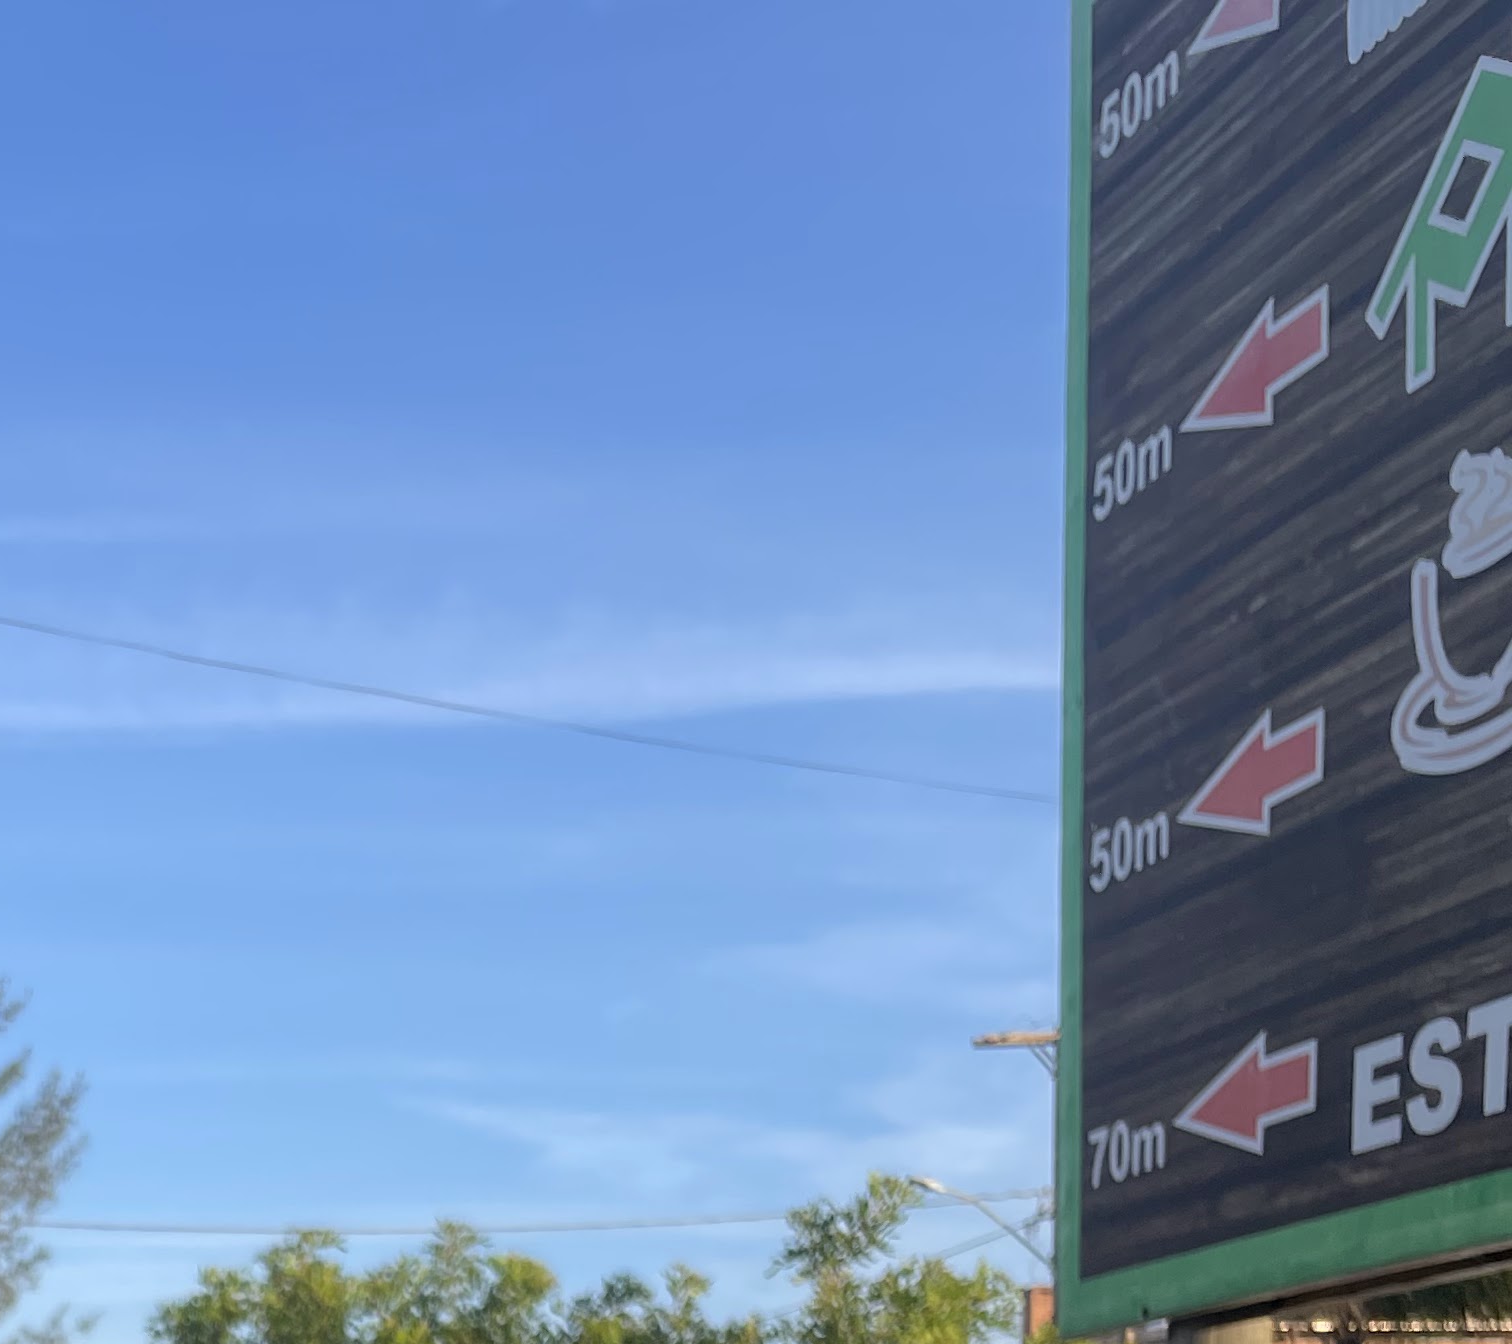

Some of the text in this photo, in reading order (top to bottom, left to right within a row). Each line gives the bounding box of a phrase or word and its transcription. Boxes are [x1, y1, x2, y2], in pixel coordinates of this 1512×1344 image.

[1099, 50, 1178, 159] 50m
[1092, 424, 1173, 522] 50m
[1089, 811, 1170, 893] 50m
[1088, 1119, 1167, 1190] 70m
